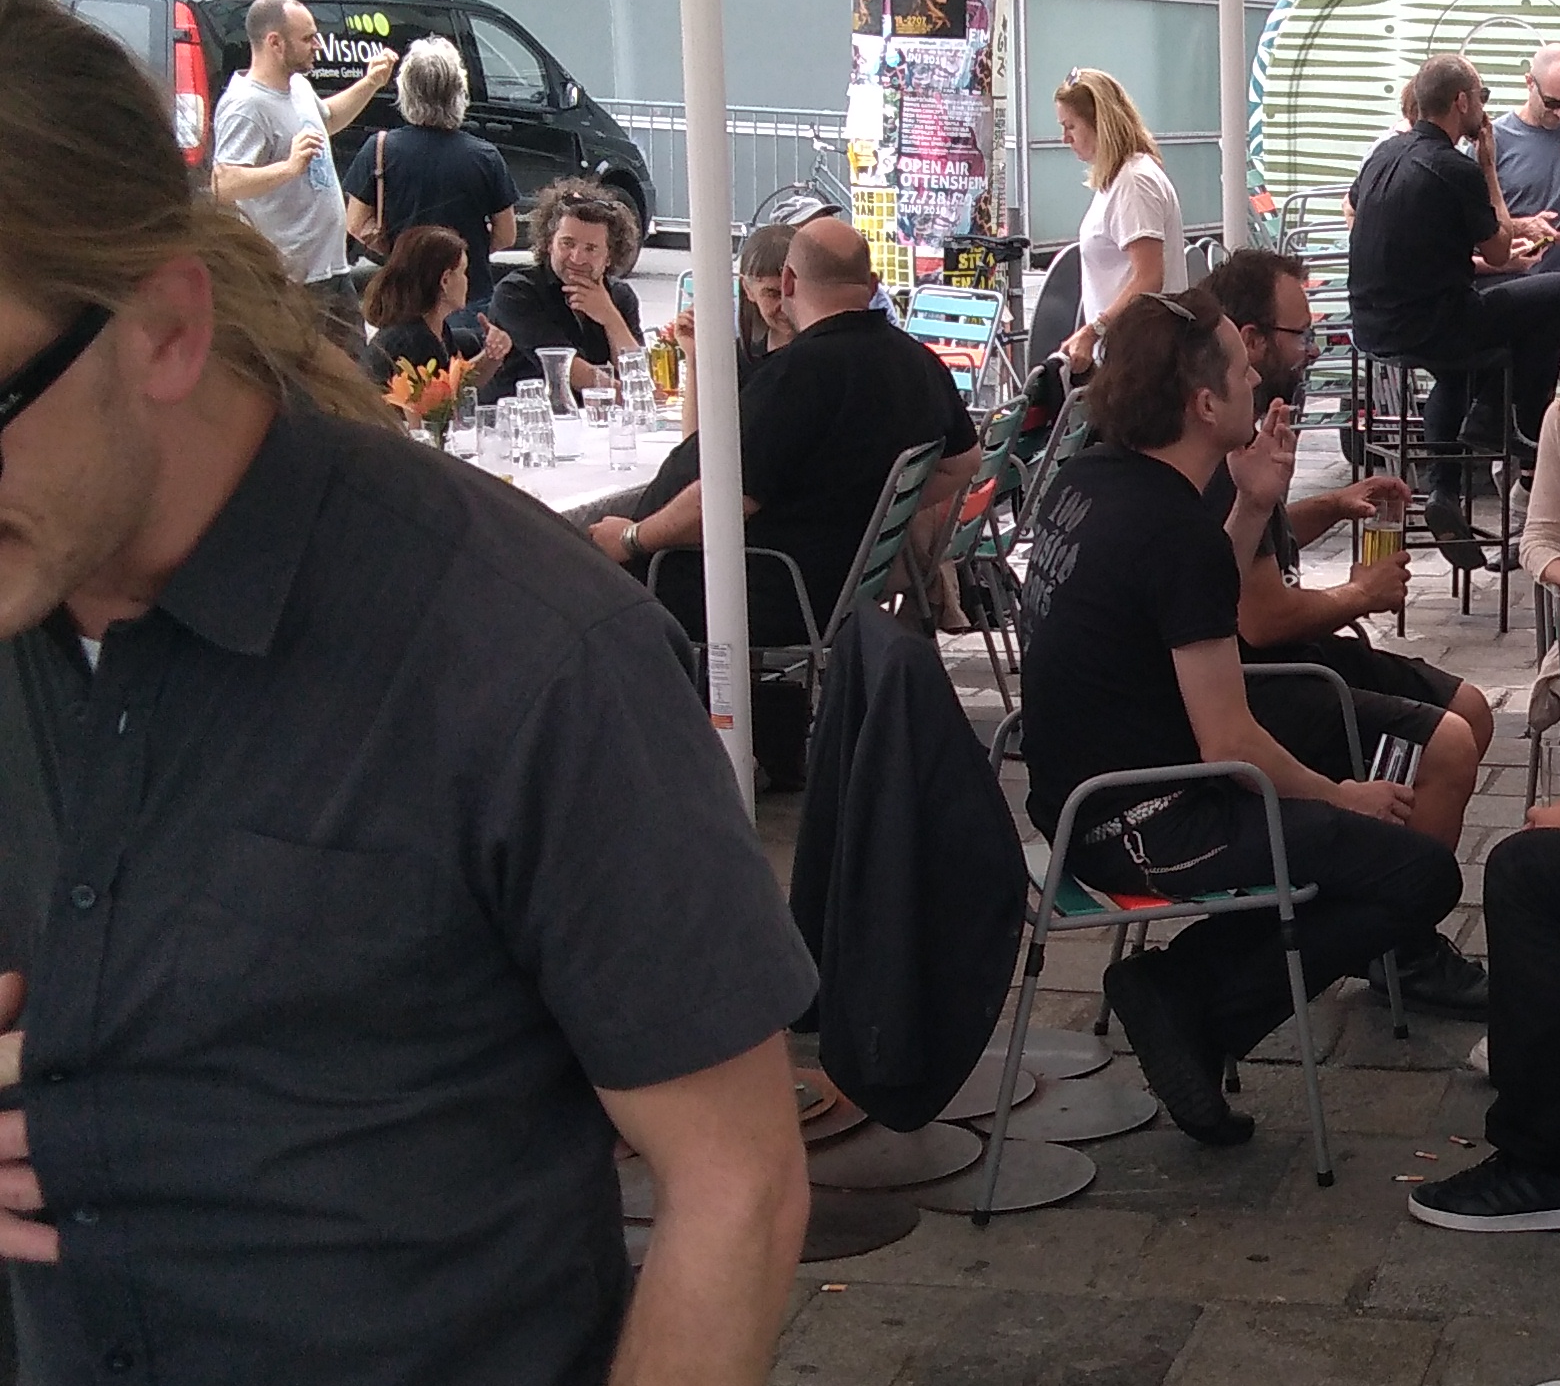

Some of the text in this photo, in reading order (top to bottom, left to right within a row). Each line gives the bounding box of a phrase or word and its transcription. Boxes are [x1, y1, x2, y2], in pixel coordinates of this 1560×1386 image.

[315, 32, 385, 63] VISION
[901, 160, 970, 176] OPEN AIR
[900, 175, 989, 191] OTTENSHEIM
[900, 205, 922, 214] JUNI
